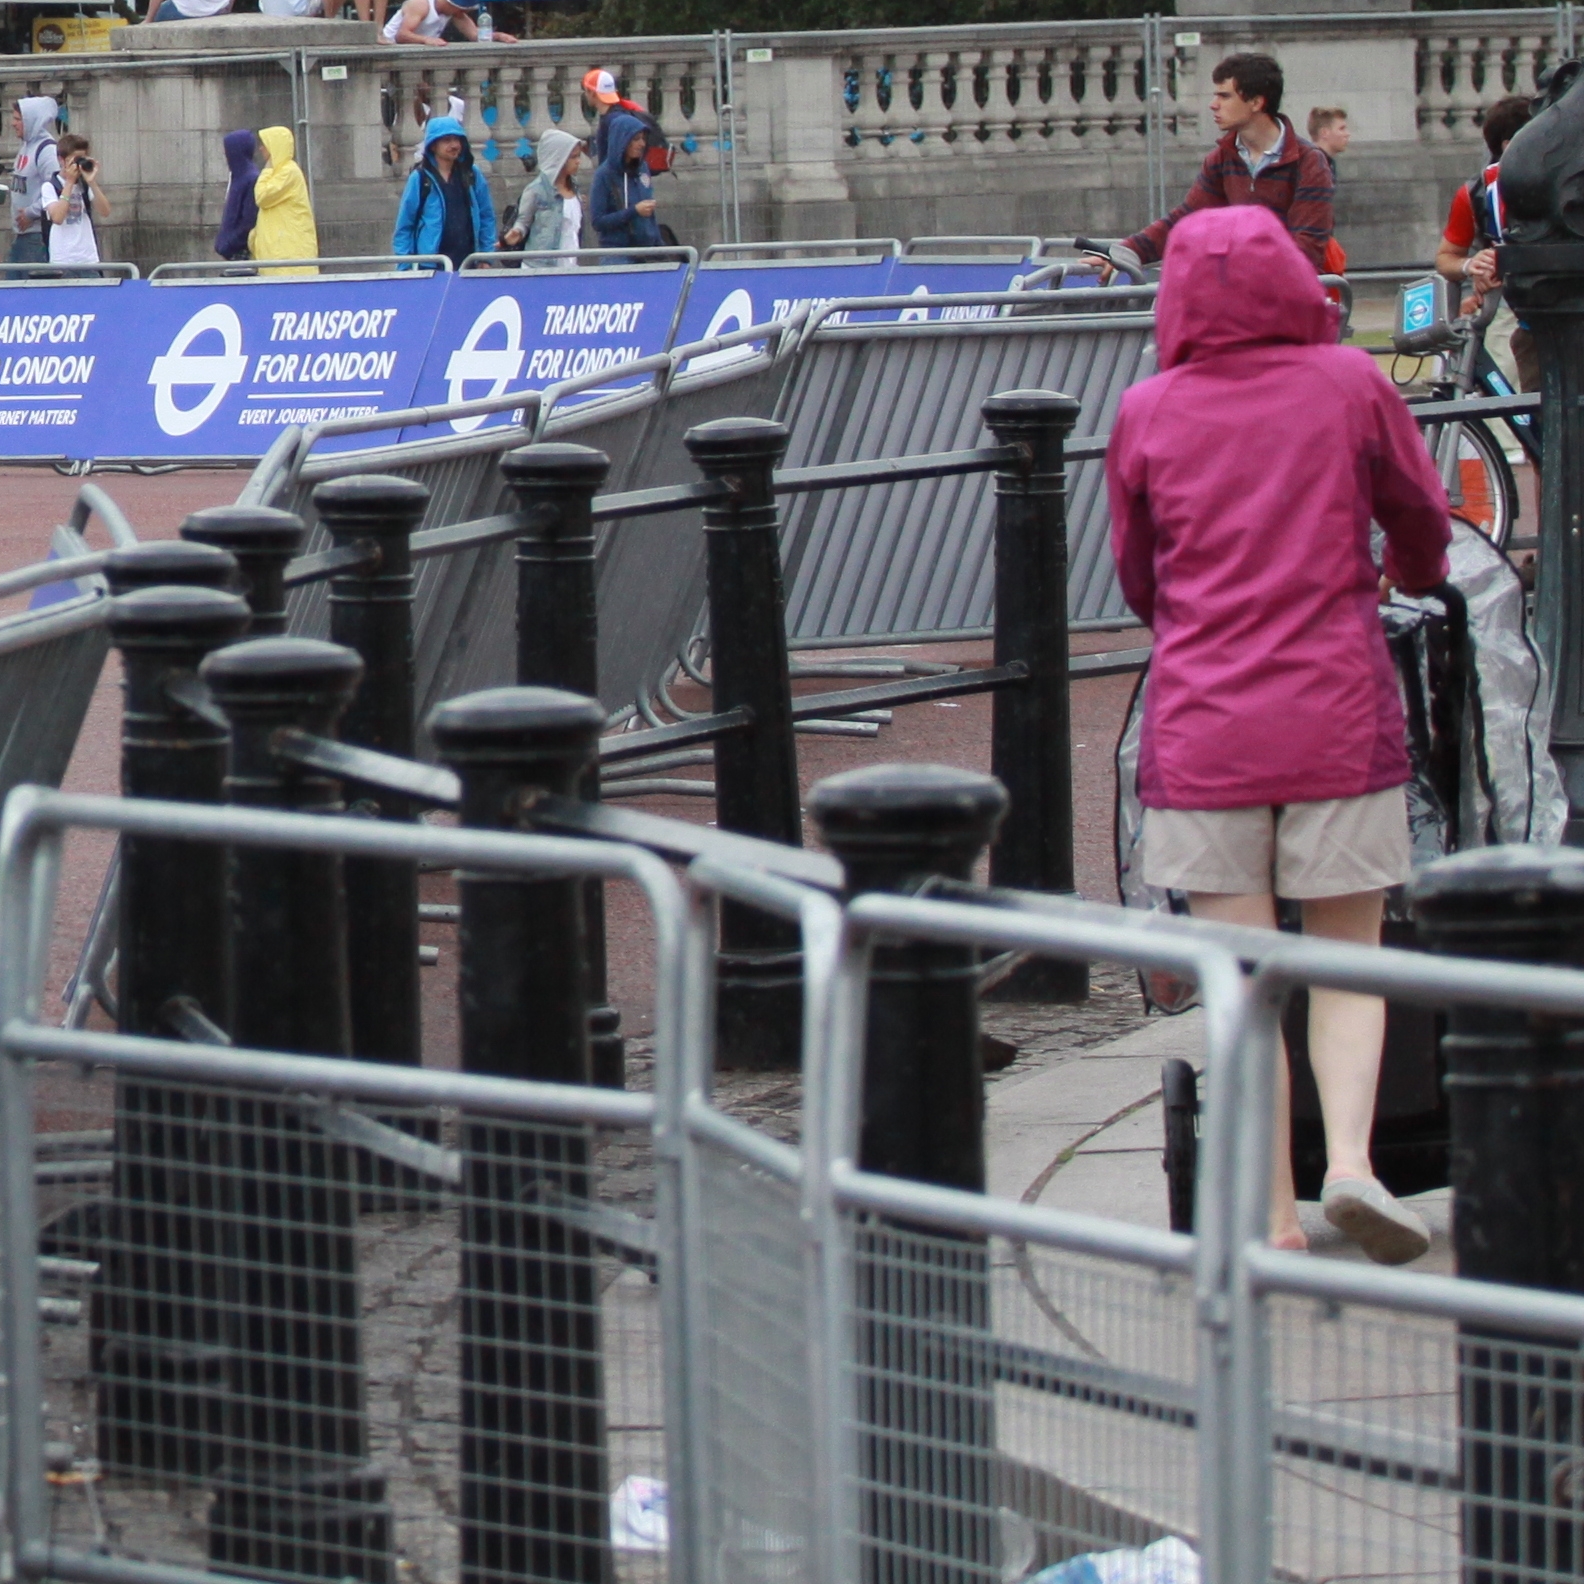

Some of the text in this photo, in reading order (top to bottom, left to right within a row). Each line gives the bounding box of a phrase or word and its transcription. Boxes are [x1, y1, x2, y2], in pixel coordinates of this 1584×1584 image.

[269, 308, 398, 341] TRANSPORT
[543, 302, 644, 335] TRANSPORT
[0, 355, 96, 385] LONDON
[252, 350, 397, 383] FOR LONDON
[526, 348, 564, 379] FOR
[27, 409, 78, 426] MATTERS
[238, 405, 379, 424] EVERY JOURNEY MATTERS
